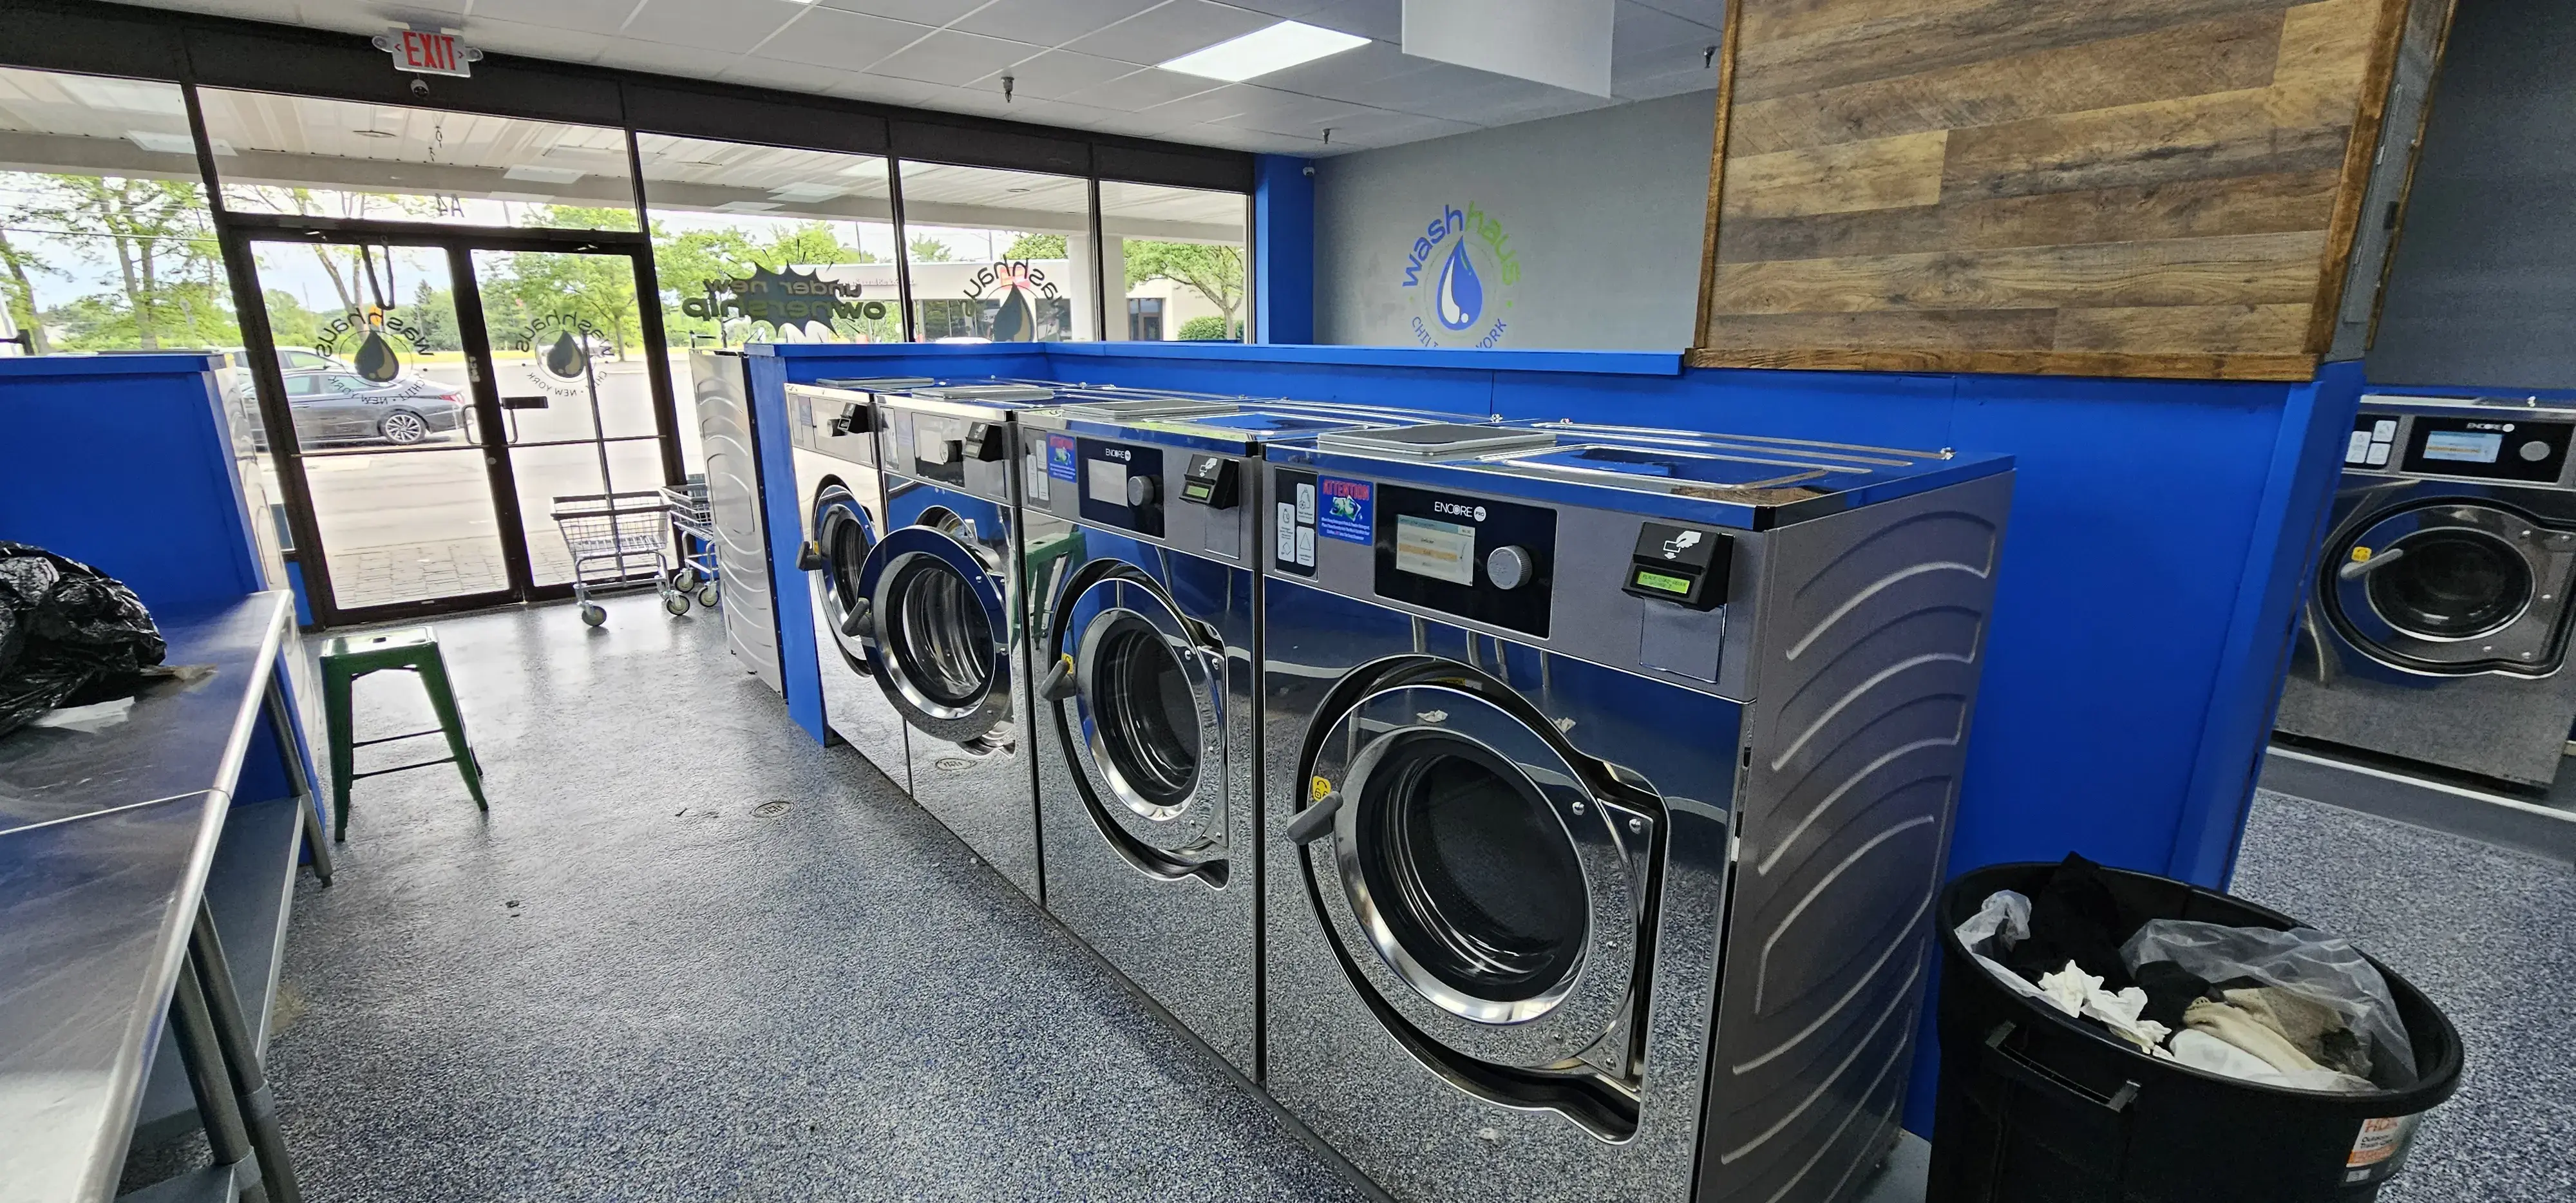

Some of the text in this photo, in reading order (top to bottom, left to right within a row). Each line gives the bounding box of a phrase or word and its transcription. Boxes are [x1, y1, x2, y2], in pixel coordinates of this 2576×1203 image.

[402, 31, 456, 70] EXIT
[1322, 478, 1370, 502] ATTENTION
[1434, 501, 1473, 518] ENCORE
